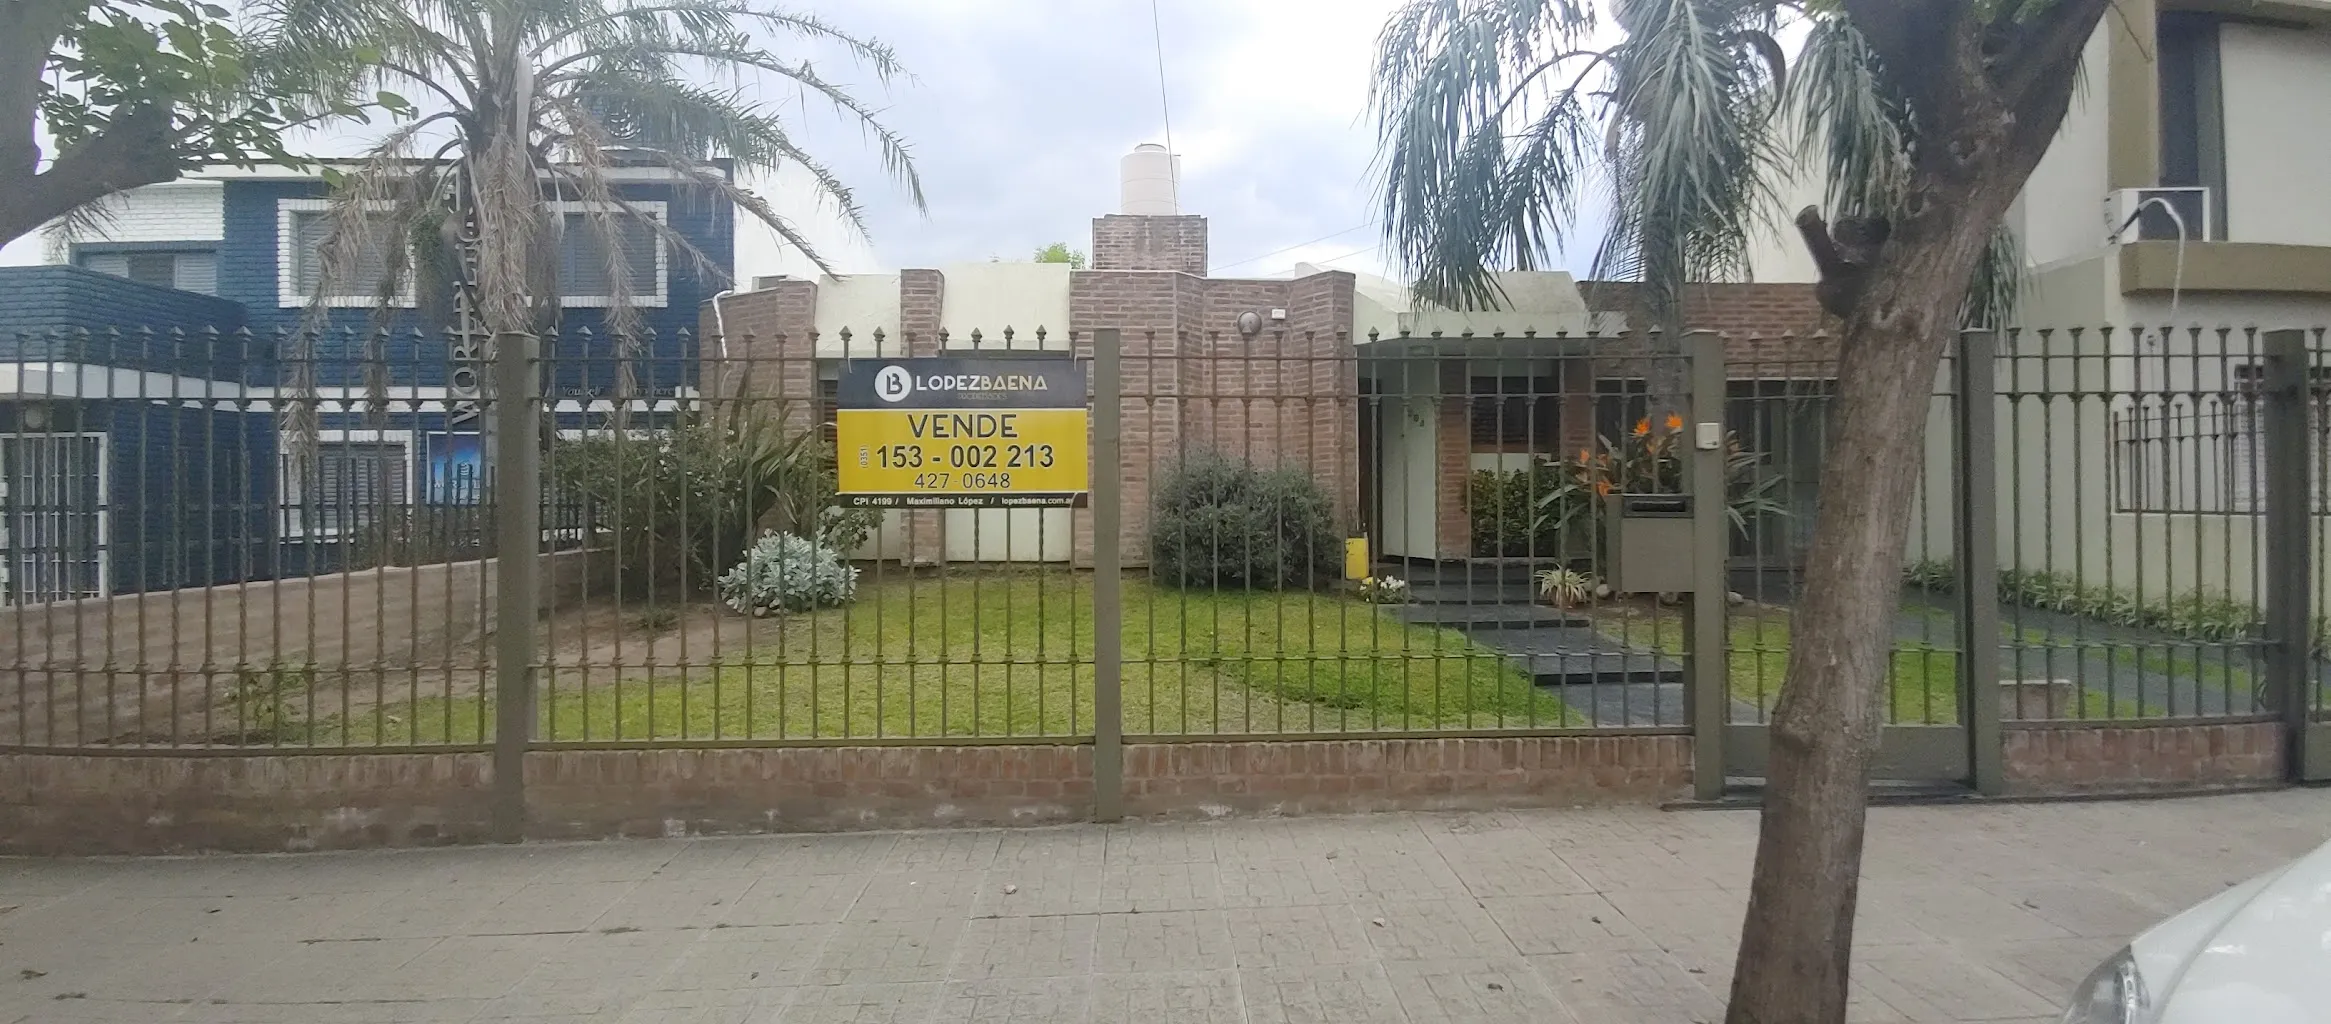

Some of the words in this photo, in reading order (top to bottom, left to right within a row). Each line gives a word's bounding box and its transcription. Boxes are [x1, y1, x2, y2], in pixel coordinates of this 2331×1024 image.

[916, 376, 1048, 391] LOPEZBAENA
[907, 414, 1018, 438] VENDE
[860, 444, 869, 469] (0351)
[876, 445, 923, 468] 153
[950, 445, 997, 468] 002
[1007, 444, 1054, 468] 213
[914, 473, 950, 489] 427
[962, 472, 1011, 489] 0648
[853, 497, 869, 506] CPI
[871, 497, 893, 506] 4199
[906, 497, 955, 505] Maximiliano
[958, 497, 984, 506] López
